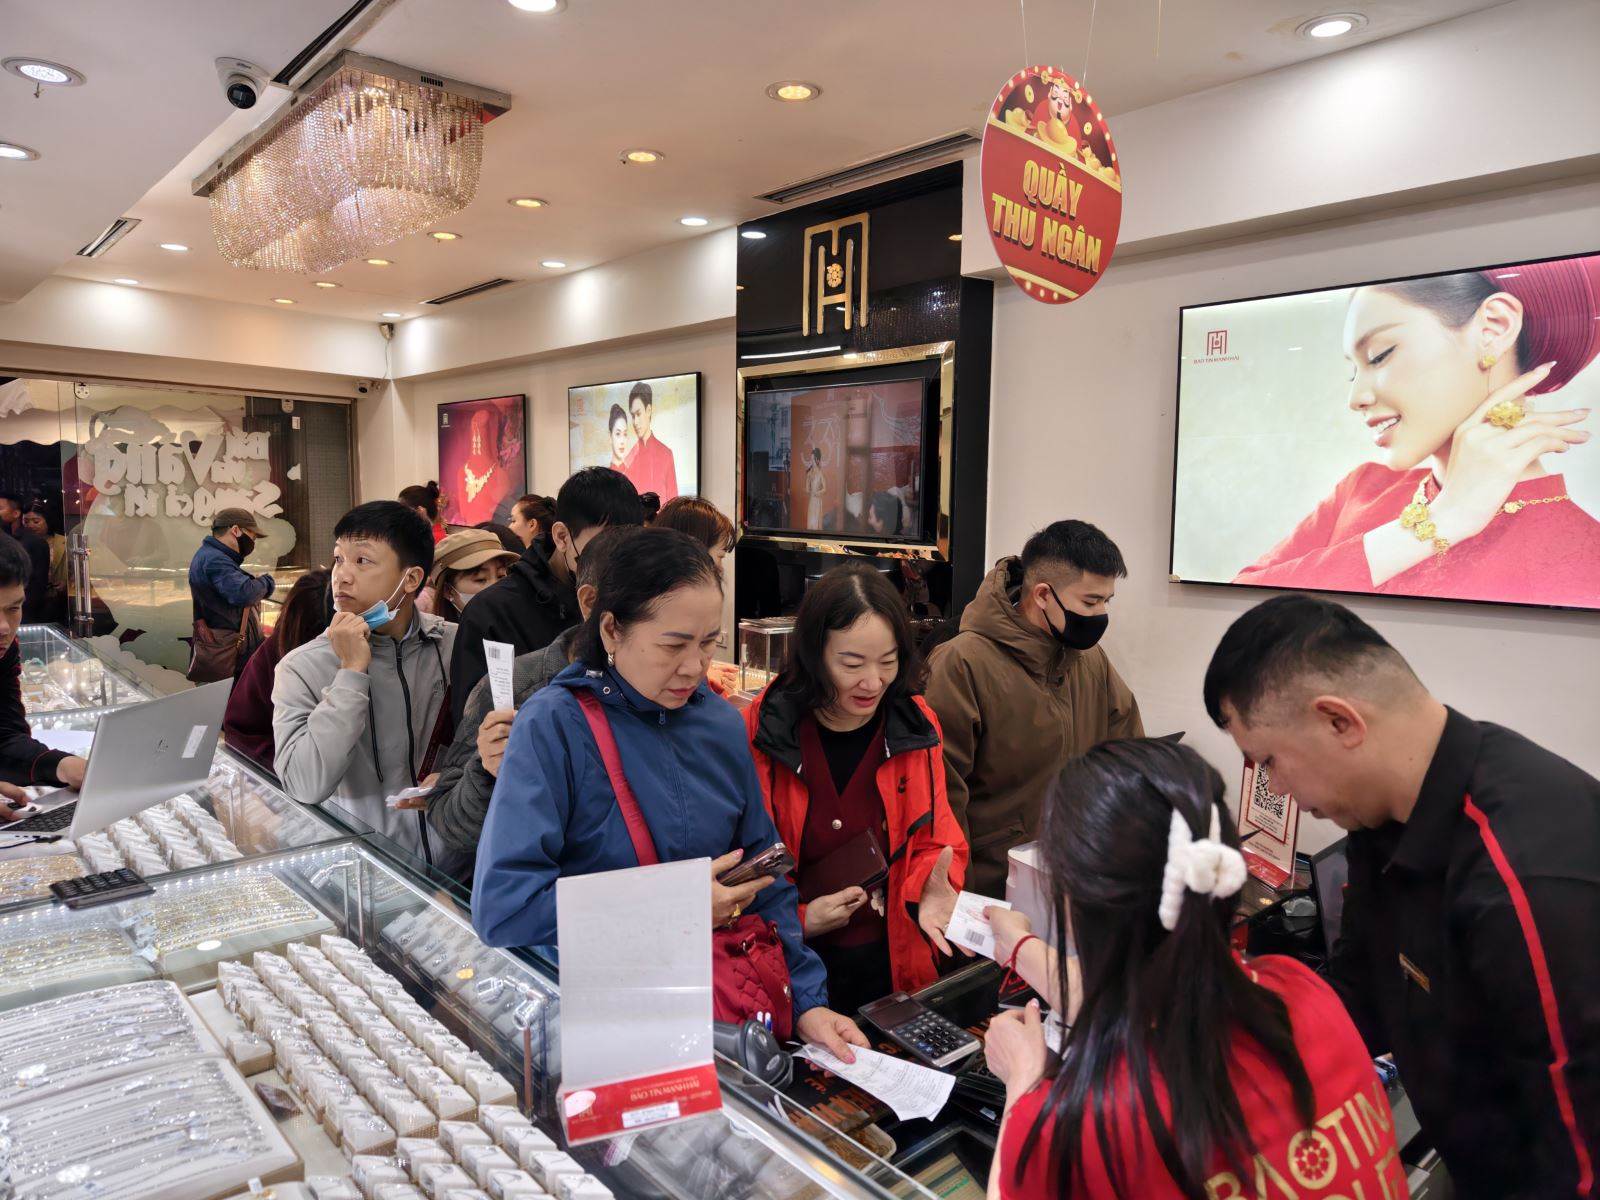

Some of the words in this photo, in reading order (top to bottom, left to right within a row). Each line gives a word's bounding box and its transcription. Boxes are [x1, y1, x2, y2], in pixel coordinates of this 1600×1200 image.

[1023, 160, 1083, 219] QUẦY
[992, 193, 1037, 248] THU
[1041, 217, 1102, 274] NGÂN
